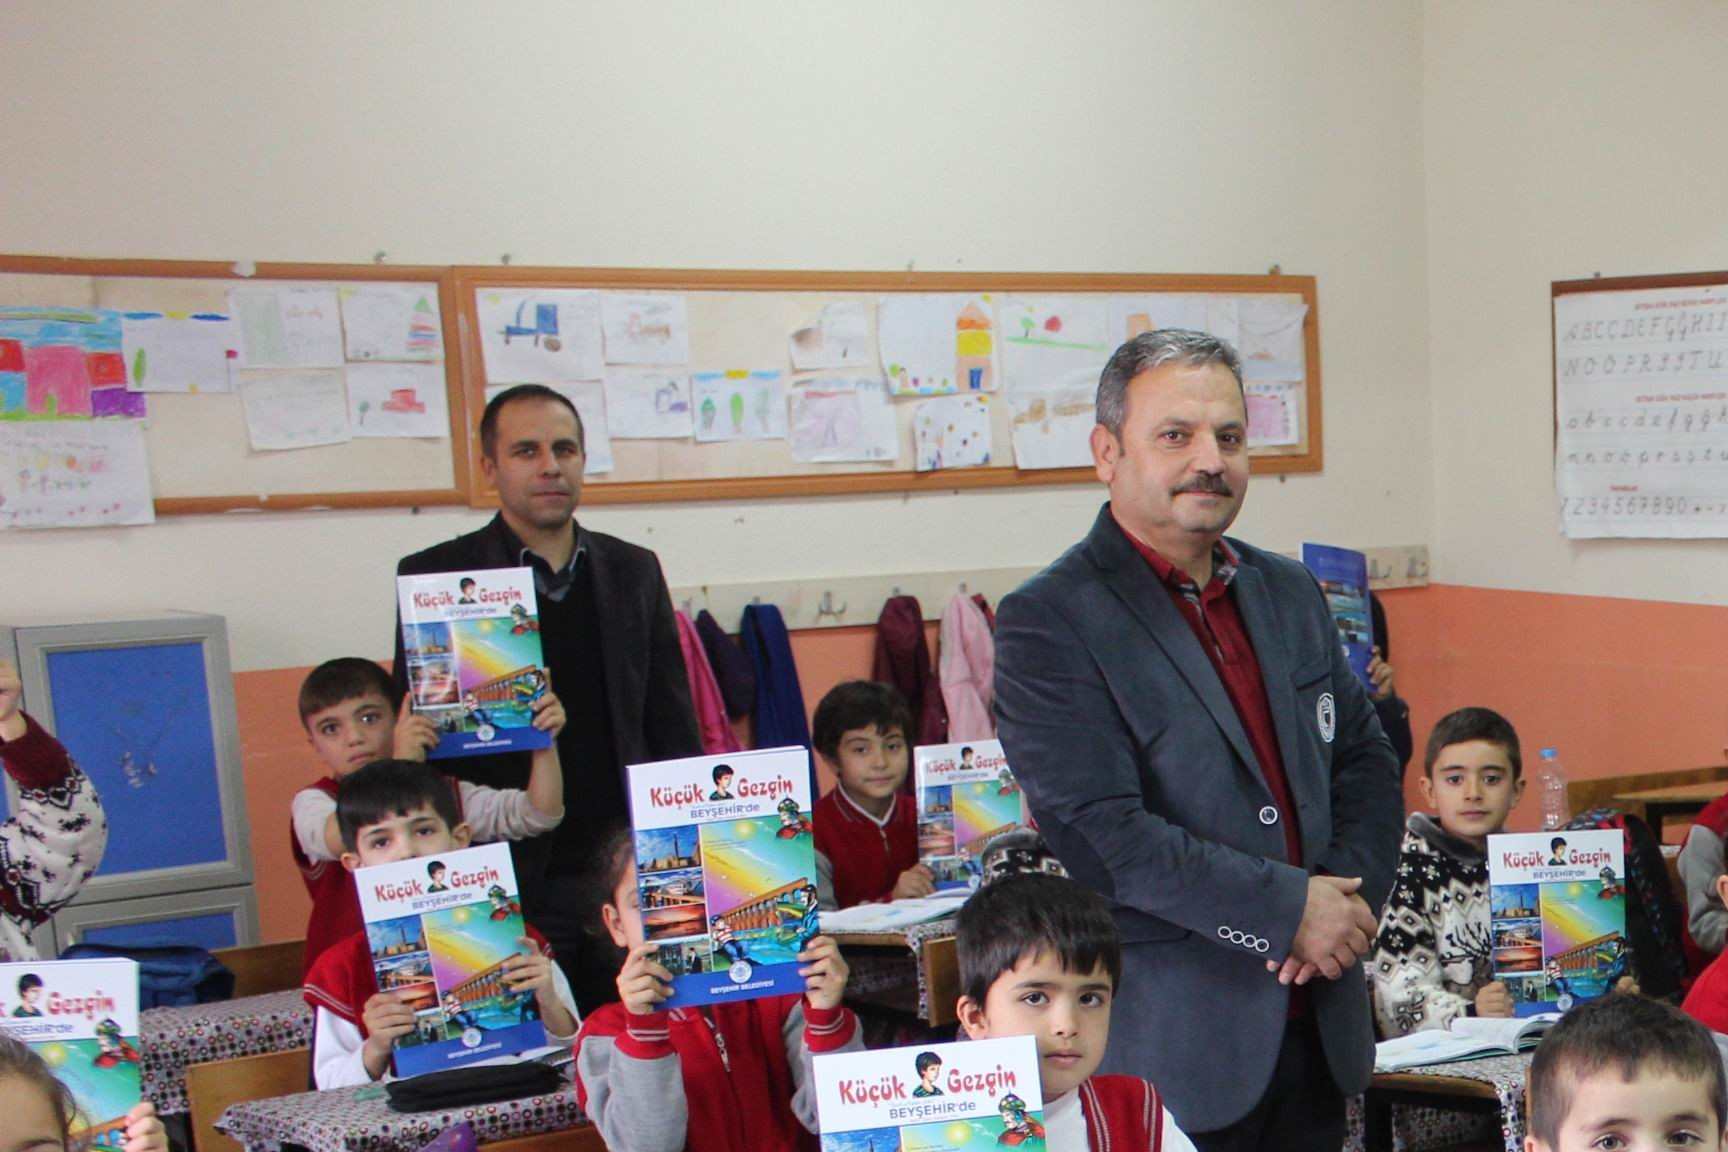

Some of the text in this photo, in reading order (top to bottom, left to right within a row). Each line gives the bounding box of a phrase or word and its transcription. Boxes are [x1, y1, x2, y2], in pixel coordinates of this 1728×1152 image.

[650, 774, 793, 810] Küçük Gezgin
[1502, 848, 1612, 871] Küçük Gezgin
[838, 1064, 1017, 1108] Küçük Gezgin
[889, 1100, 977, 1120] BEYŞEHİR'de
